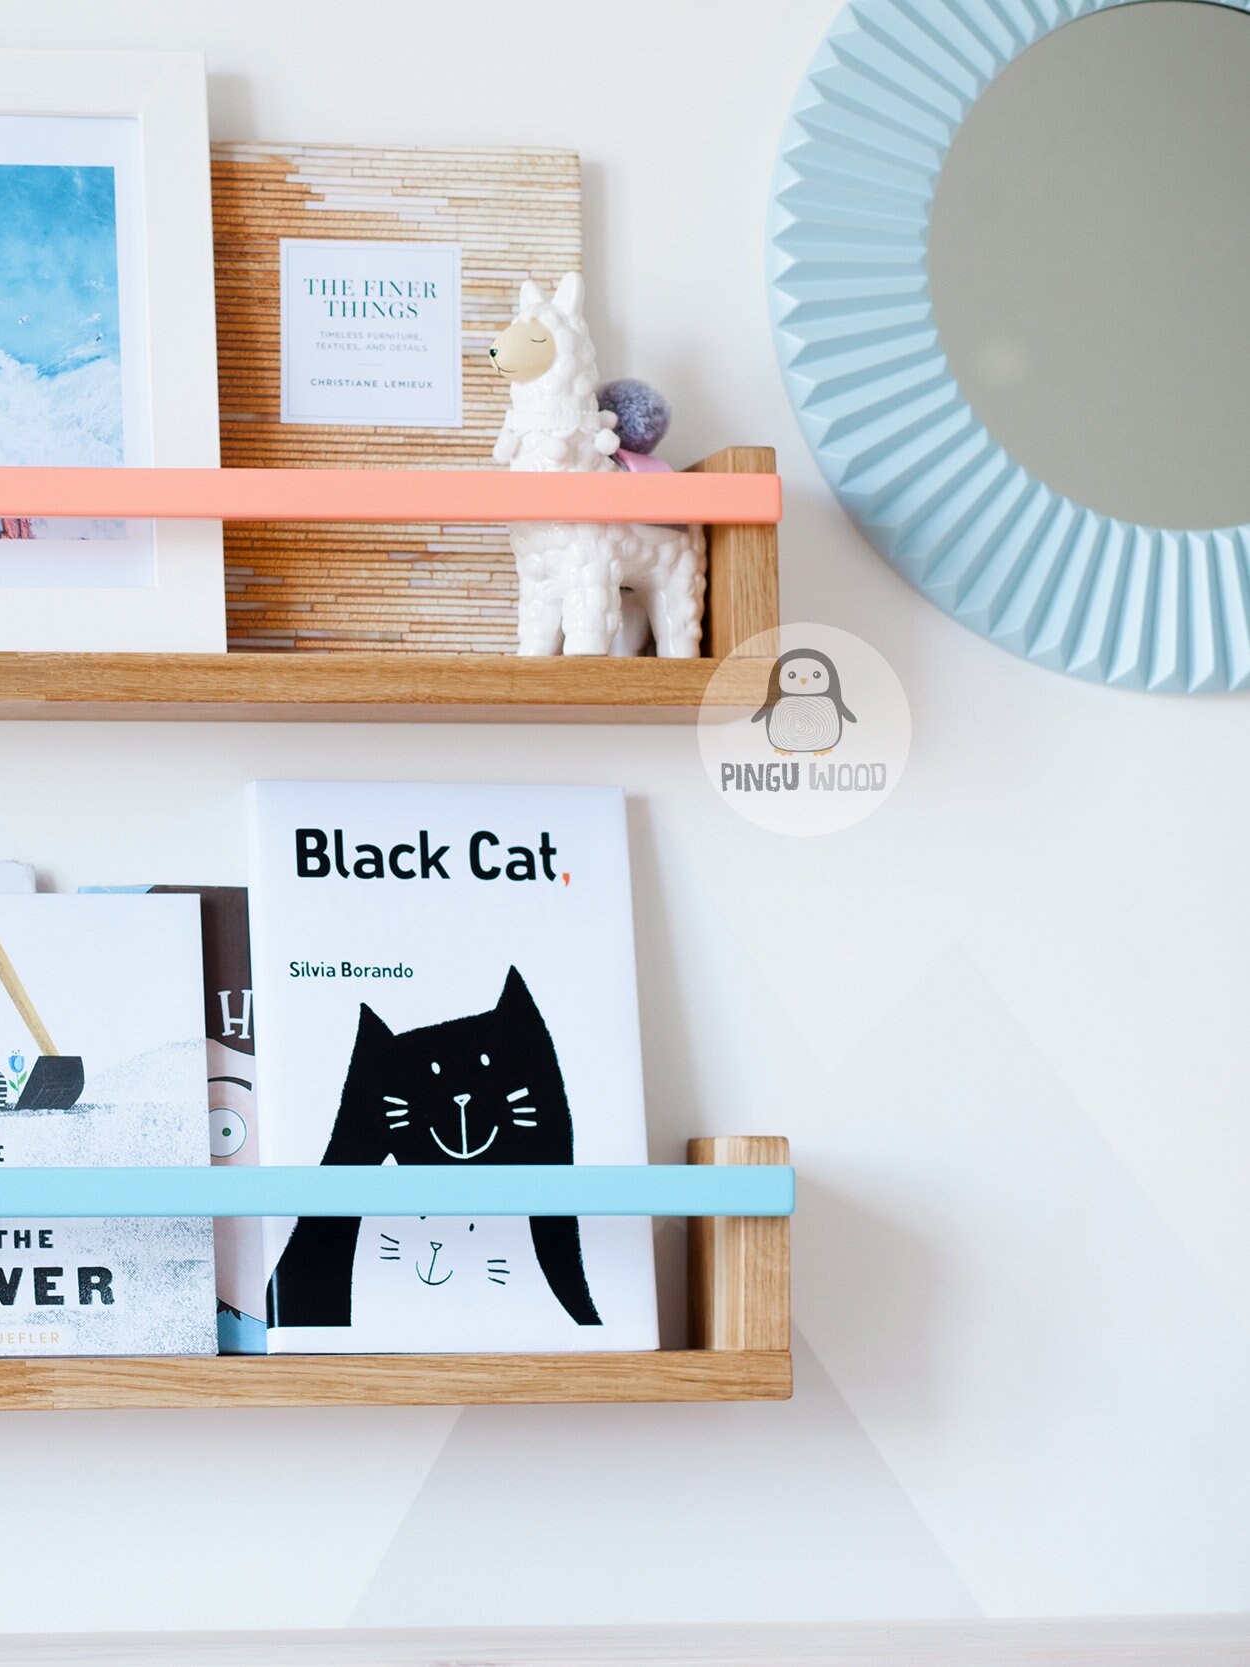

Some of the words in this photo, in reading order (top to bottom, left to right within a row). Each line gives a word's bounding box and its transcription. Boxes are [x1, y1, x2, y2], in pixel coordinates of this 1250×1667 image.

[303, 278, 355, 297] THE
[364, 279, 438, 299] FINER
[323, 300, 419, 319] THINGS
[320, 331, 364, 340] TIMELESS
[367, 332, 423, 341] FURNITURE,
[315, 342, 362, 352] TEXTILES,
[365, 343, 386, 352] AND
[389, 344, 428, 353] DETAILS
[310, 378, 378, 388] CHRISTIANE
[384, 379, 433, 389] LEMIEUX
[295, 828, 451, 880] Black
[469, 830, 571, 888] Cat,
[289, 961, 337, 978] Silvia
[341, 961, 414, 979] Borando
